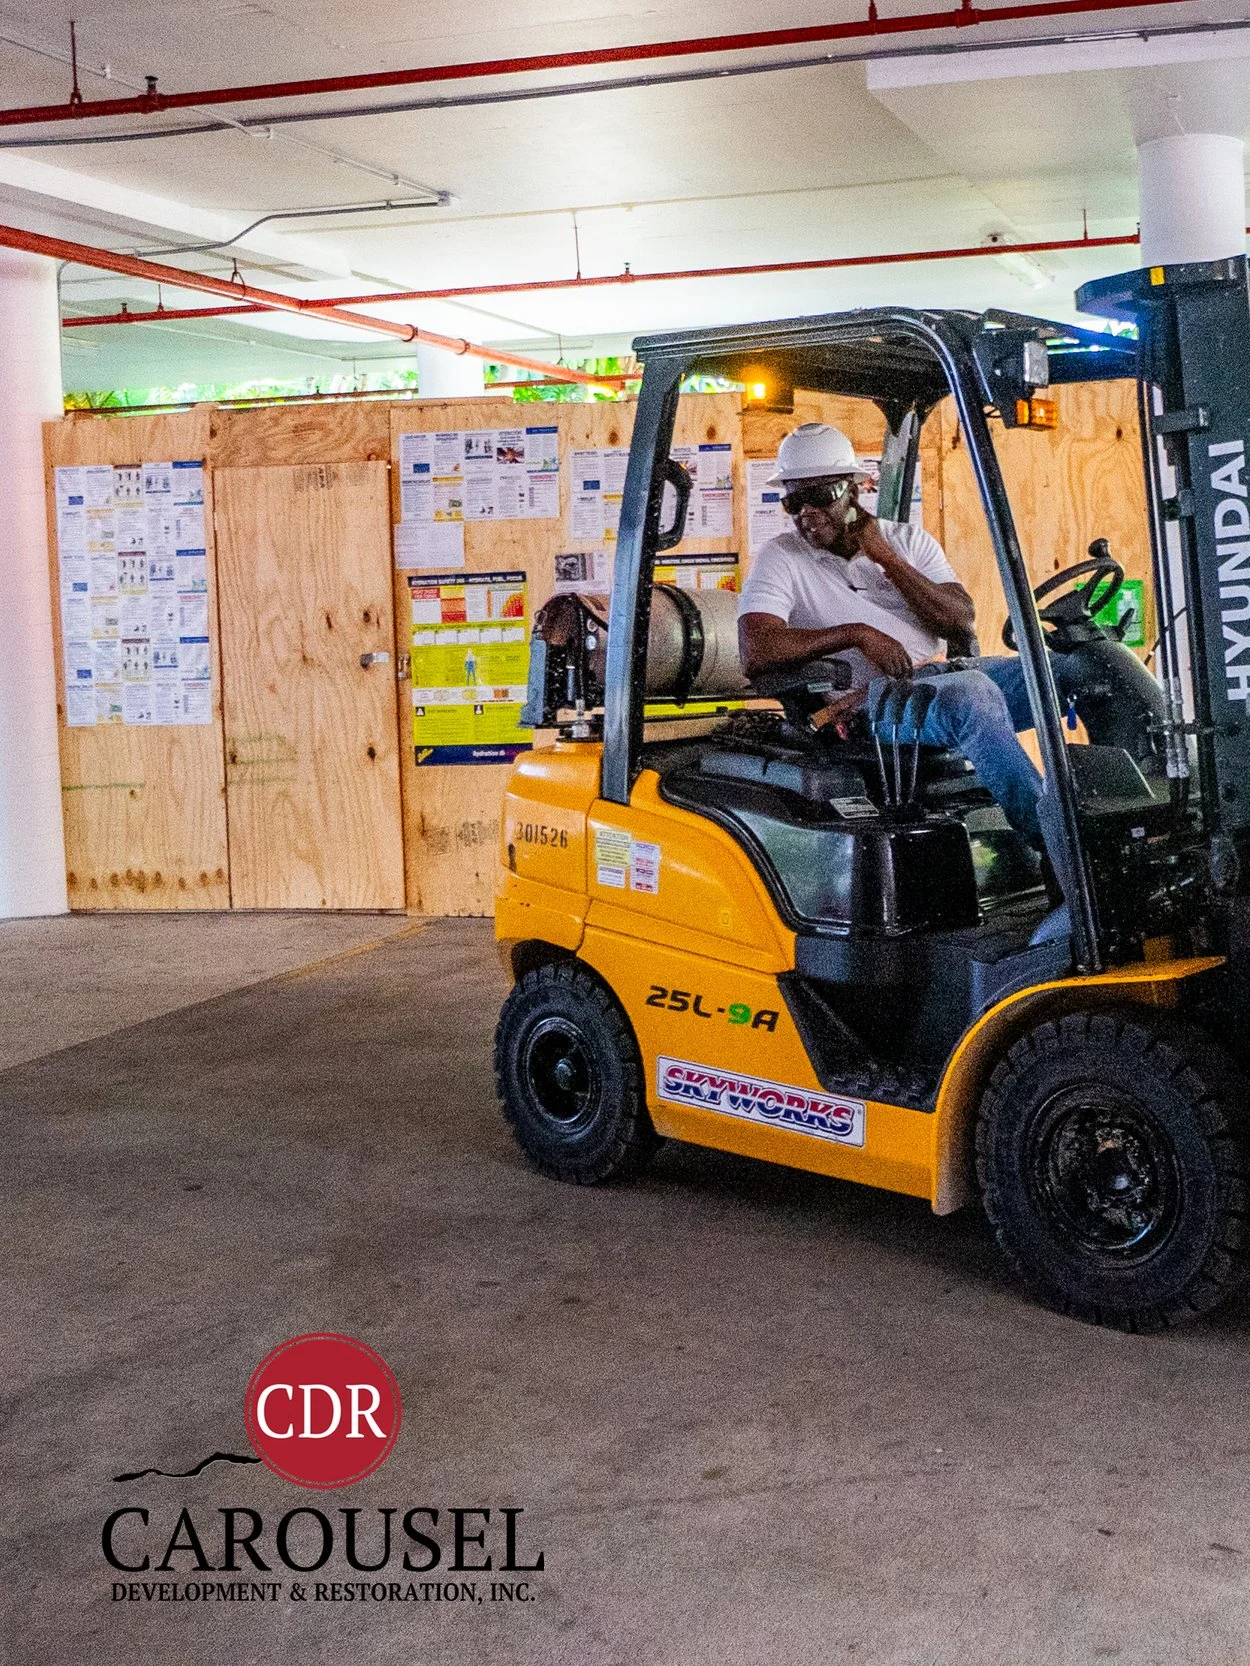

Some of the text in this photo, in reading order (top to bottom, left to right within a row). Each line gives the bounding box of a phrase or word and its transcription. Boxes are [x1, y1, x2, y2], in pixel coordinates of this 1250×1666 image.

[515, 822, 569, 848] 301526
[645, 985, 780, 1032] 25L-9A
[663, 1064, 855, 1136] SKYWORKS
